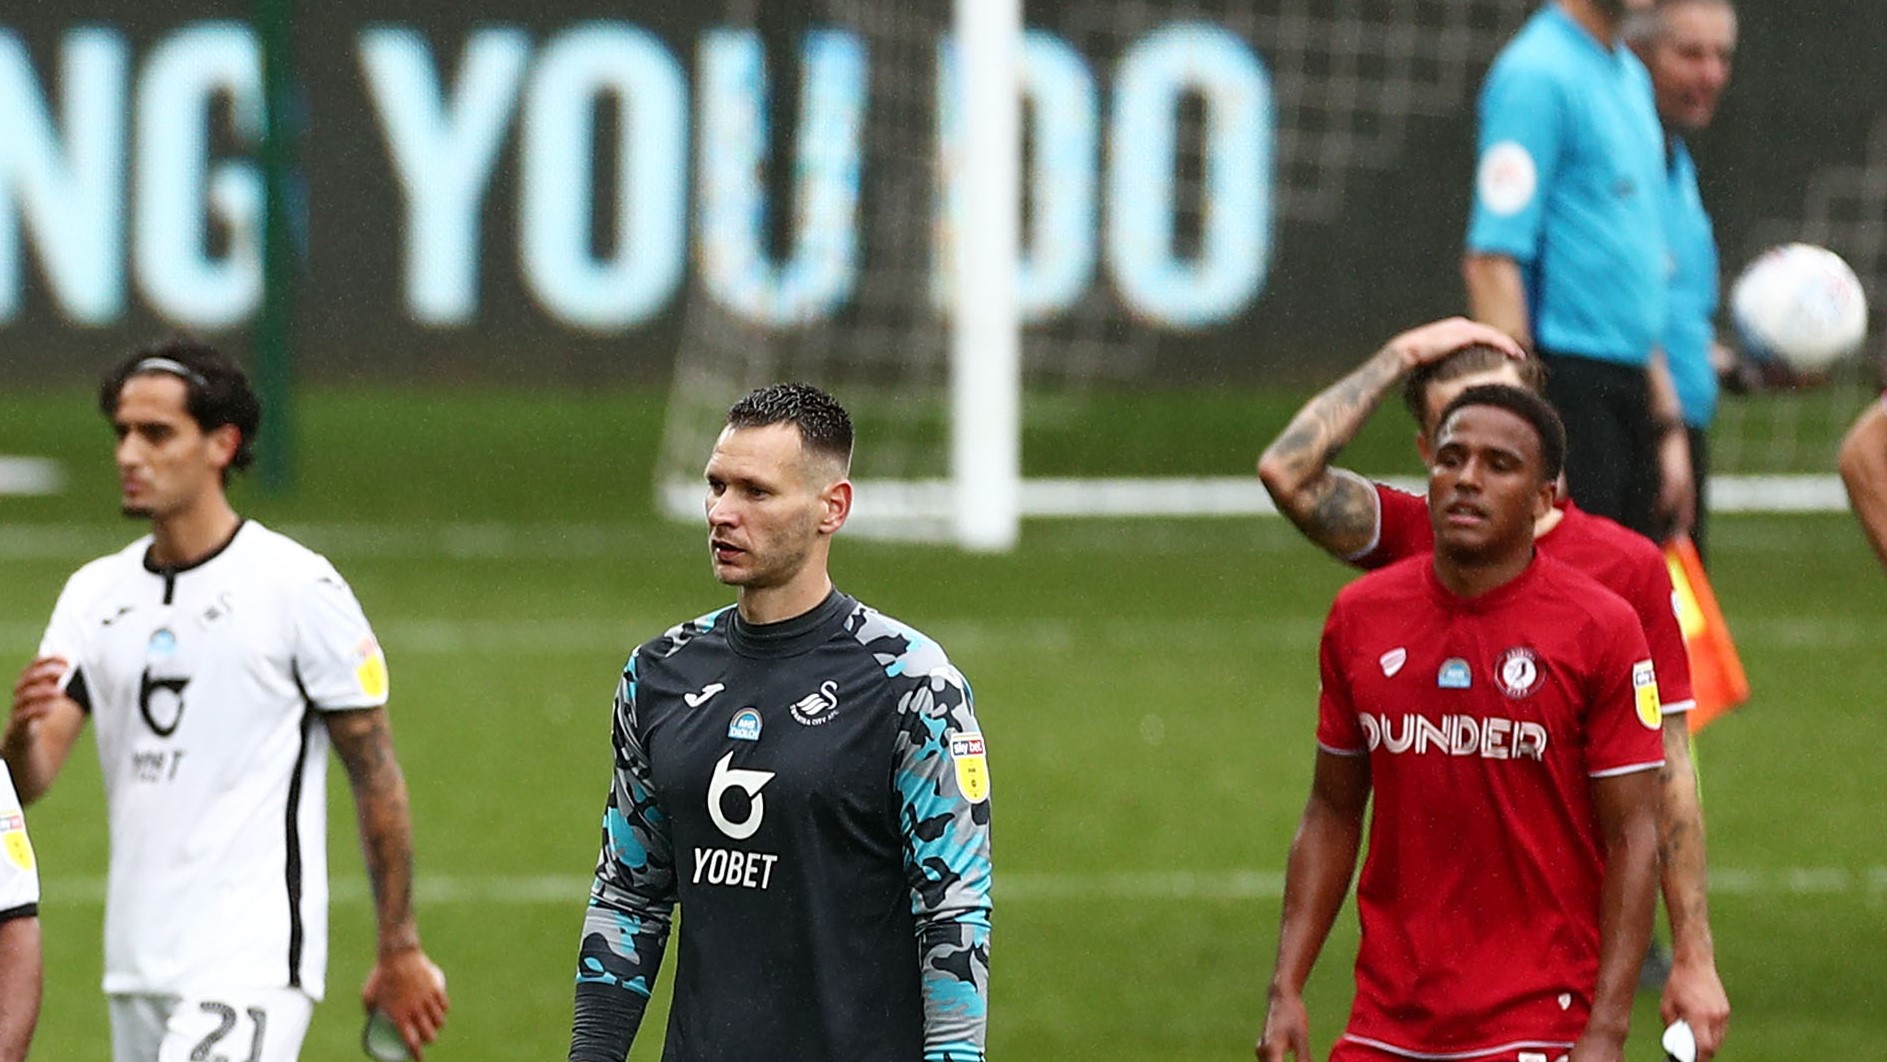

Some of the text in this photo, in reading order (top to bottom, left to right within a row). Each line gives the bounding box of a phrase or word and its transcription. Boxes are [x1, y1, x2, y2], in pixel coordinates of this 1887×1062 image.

[358, 24, 869, 330] YOU
[934, 24, 1278, 330] DO
[693, 847, 778, 889] YOBET
